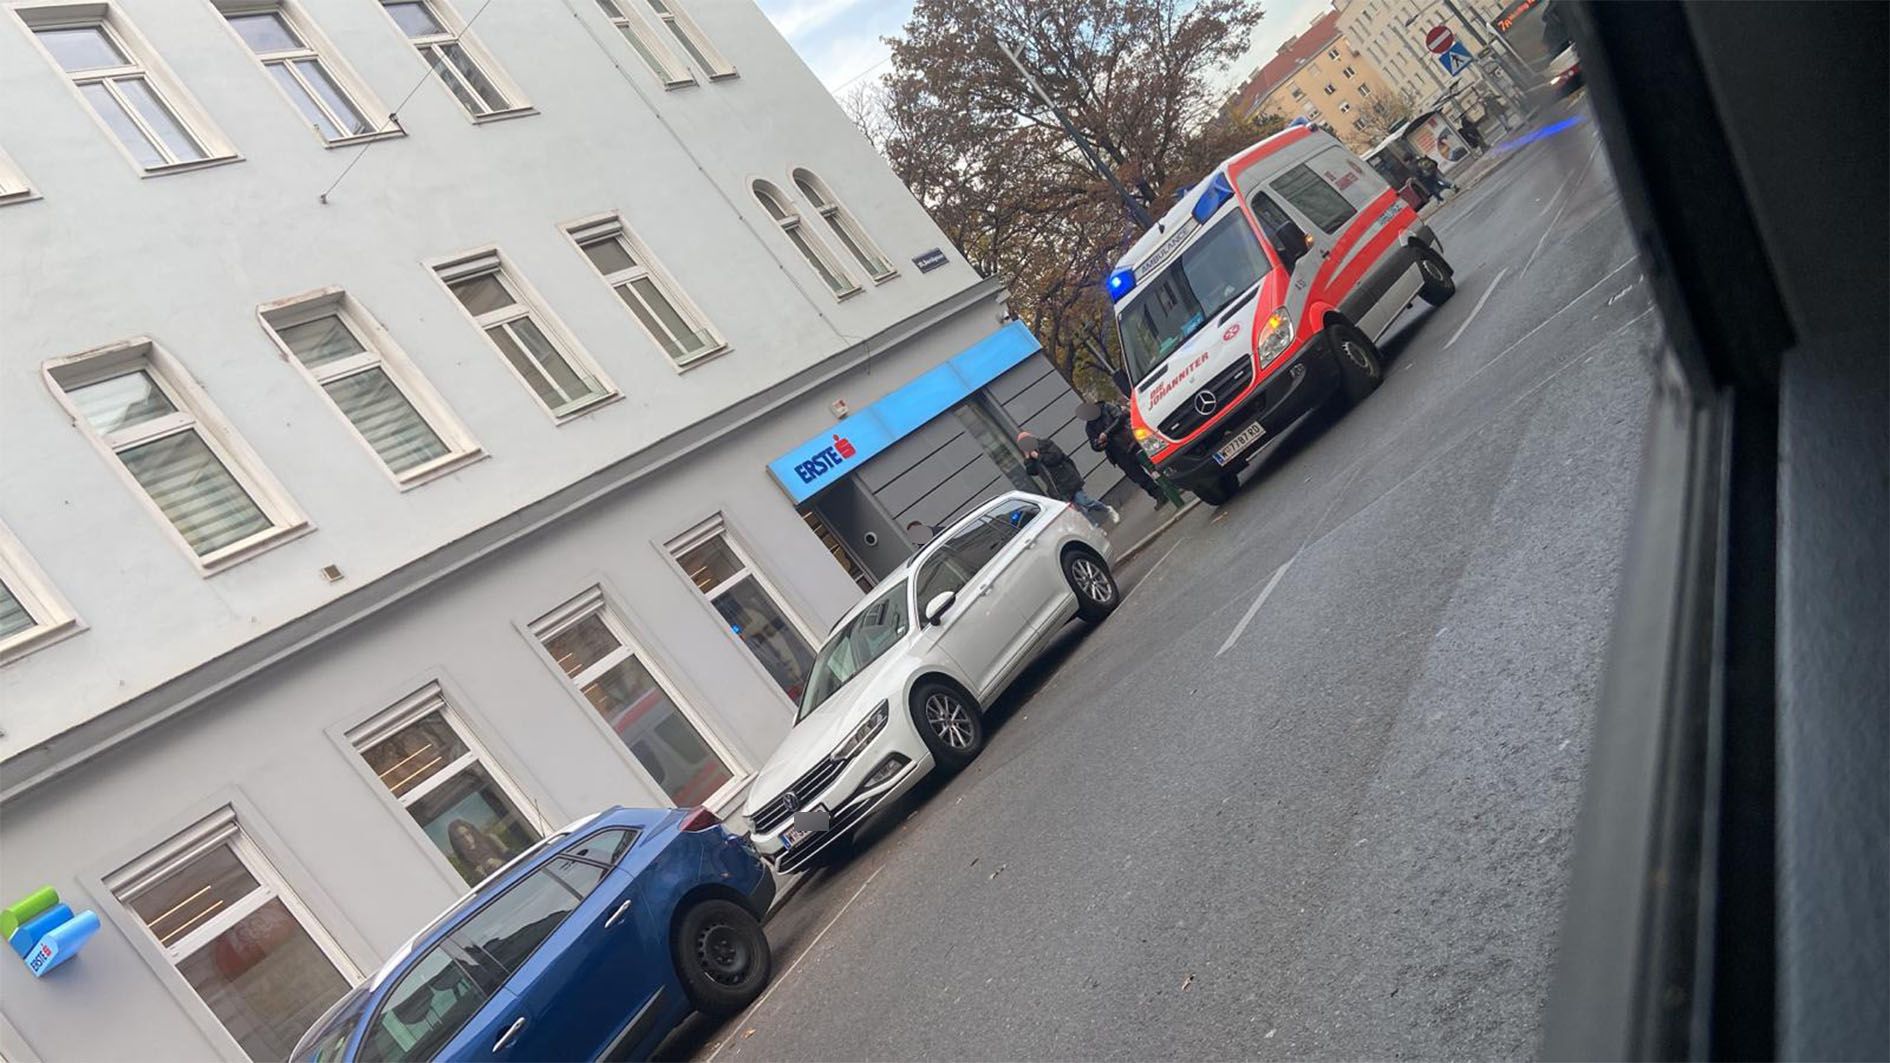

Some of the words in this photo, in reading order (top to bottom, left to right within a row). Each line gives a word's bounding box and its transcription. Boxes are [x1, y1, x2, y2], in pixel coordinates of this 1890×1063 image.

[1141, 230, 1187, 273] AMBULANCE
[1149, 352, 1208, 411] JOHANNITER
[794, 446, 843, 484] ERSTE
[30, 951, 47, 972] ERSTE
